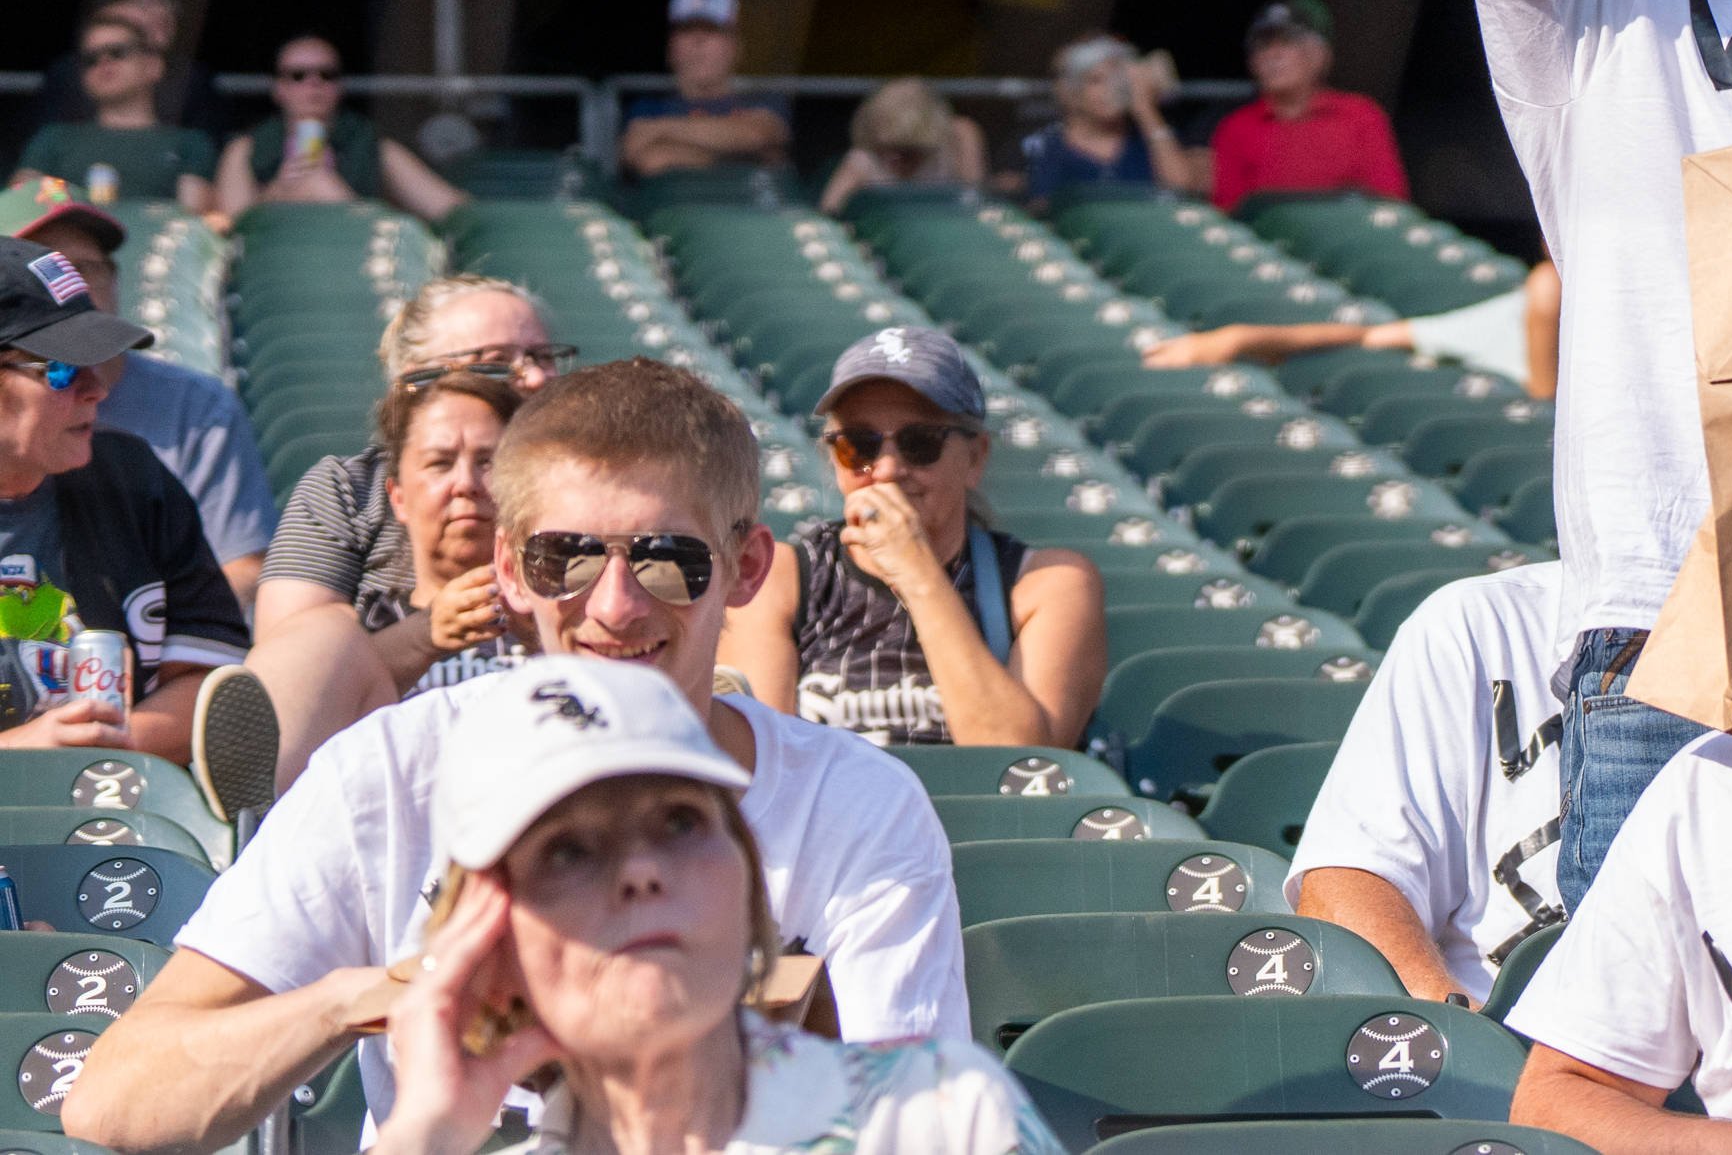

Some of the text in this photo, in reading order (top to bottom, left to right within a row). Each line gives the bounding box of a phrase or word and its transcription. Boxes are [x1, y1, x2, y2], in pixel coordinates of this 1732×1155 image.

[93, 778, 122, 807] 2
[103, 881, 134, 910] 2
[1192, 876, 1223, 904] 4
[1255, 953, 1288, 984] 4
[75, 975, 108, 1007] 2
[1378, 1040, 1415, 1073] 4
[50, 1058, 85, 1094] 2
